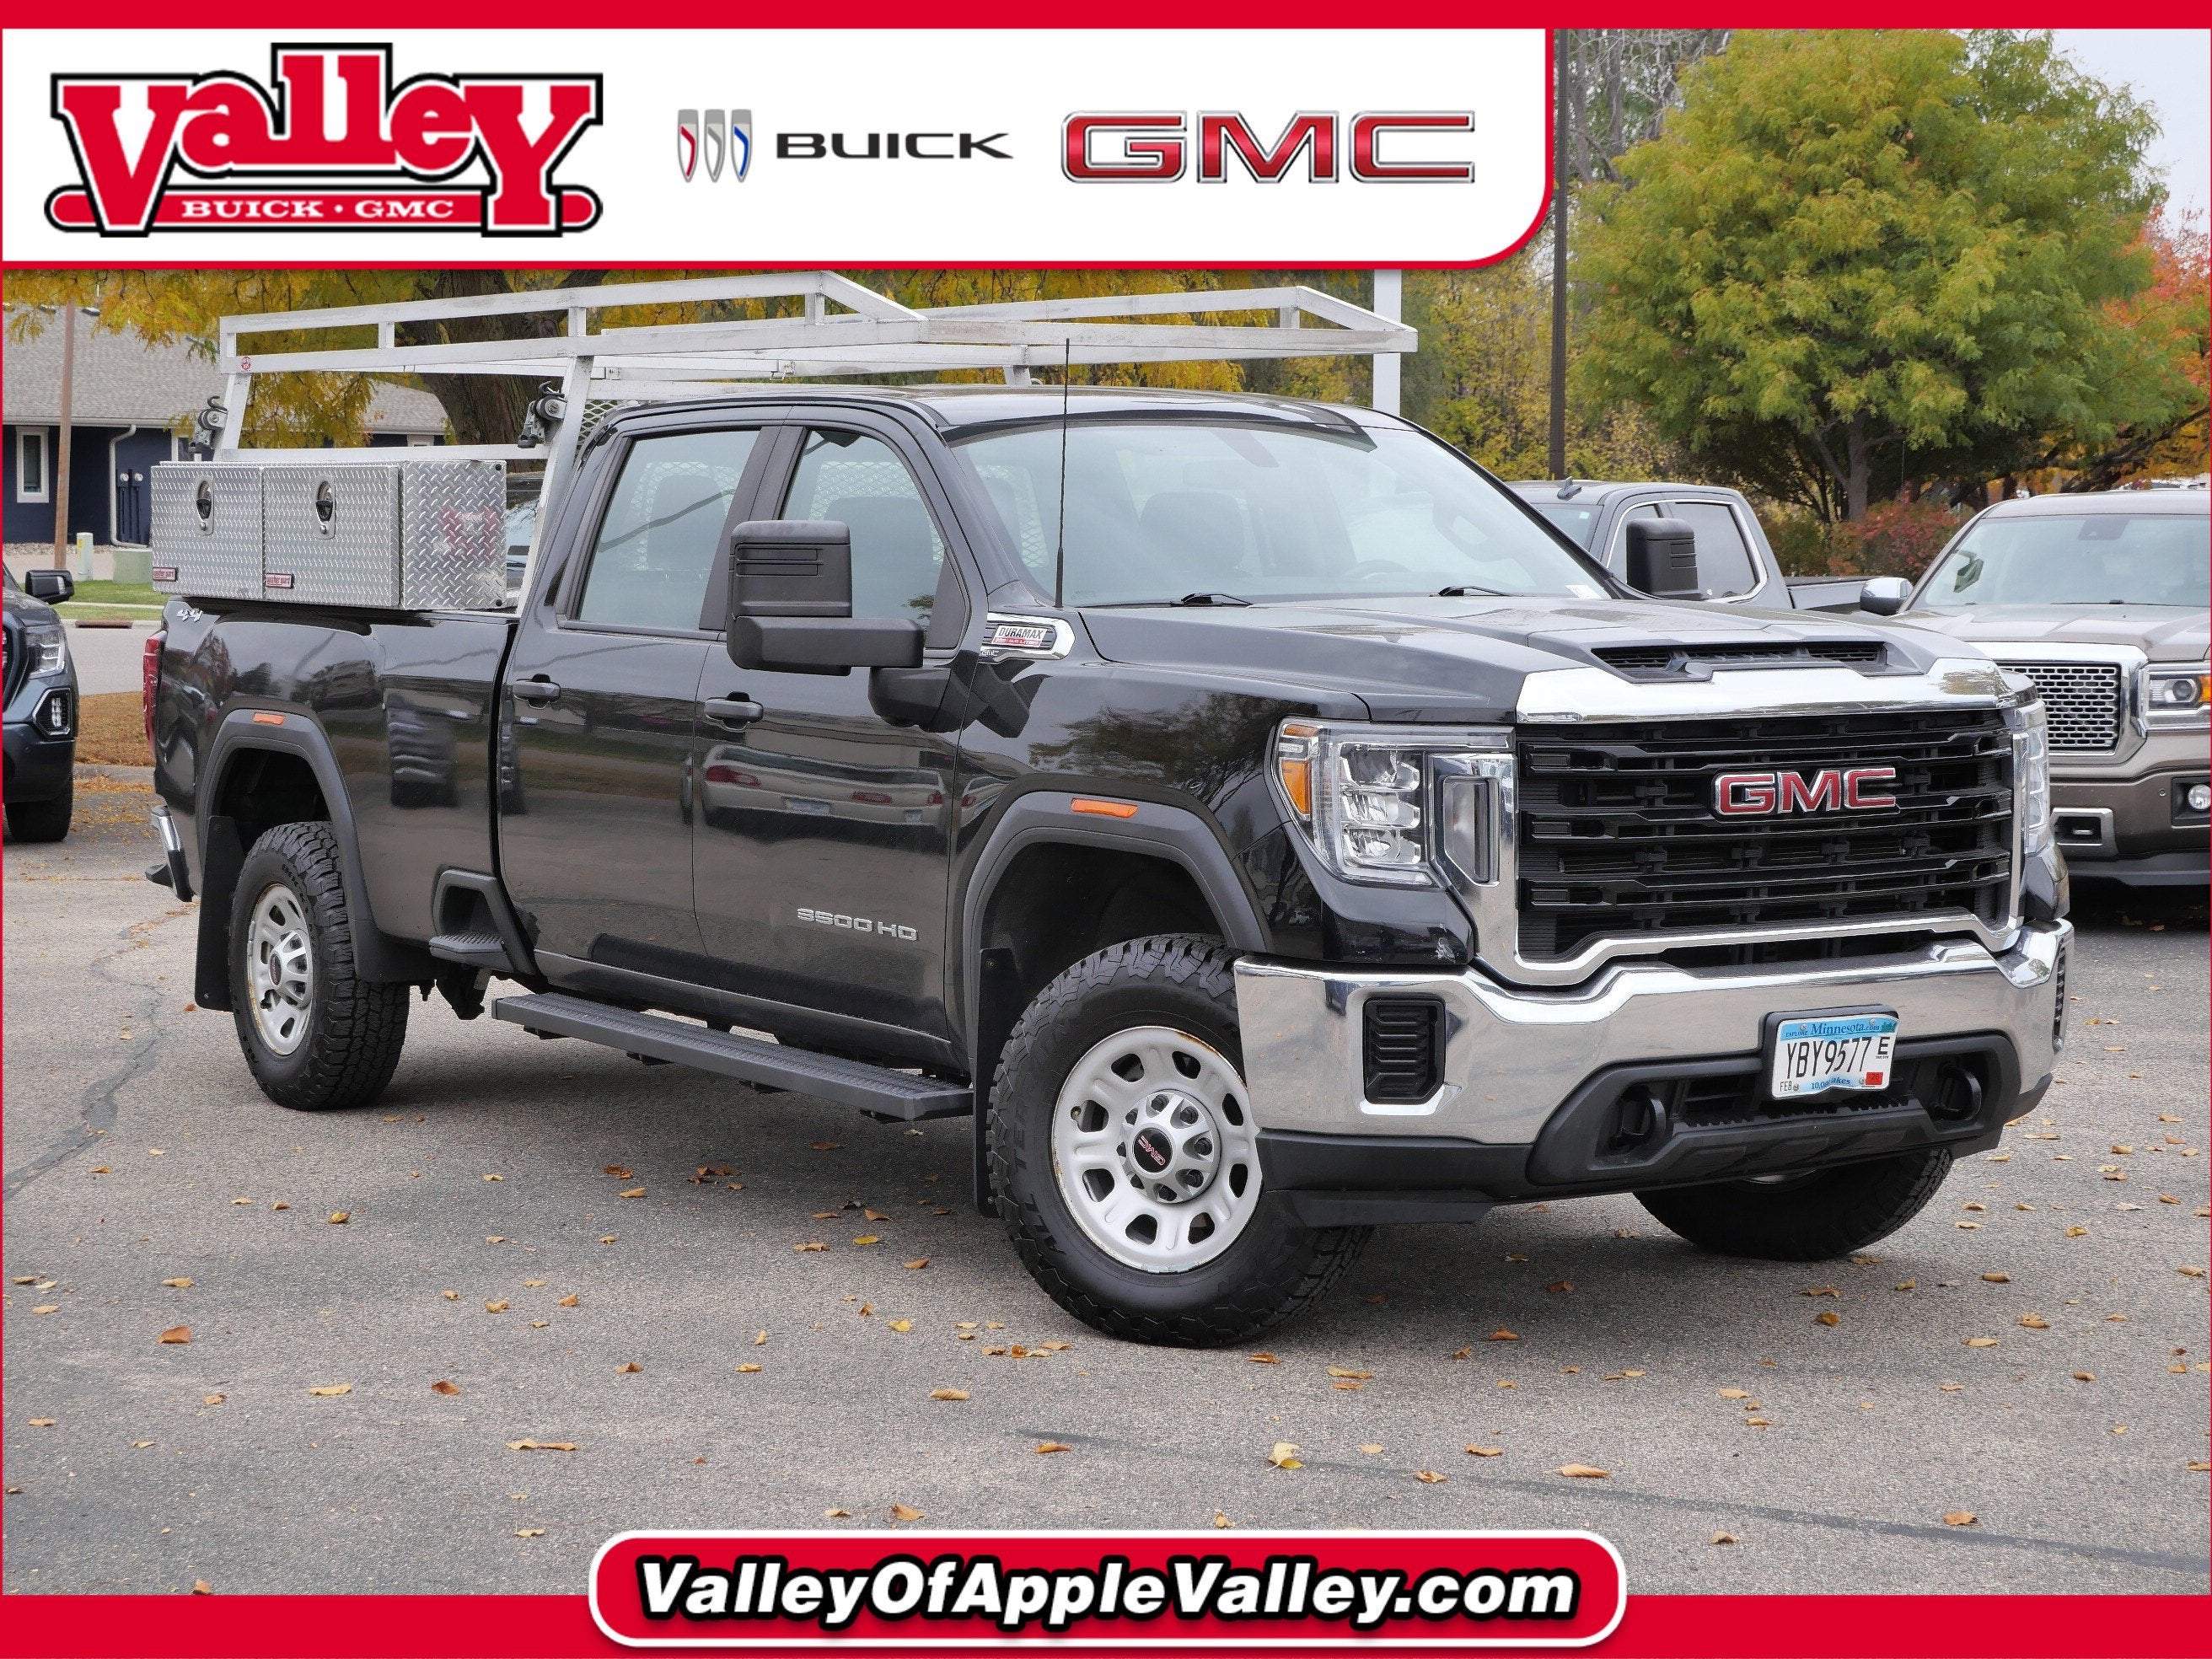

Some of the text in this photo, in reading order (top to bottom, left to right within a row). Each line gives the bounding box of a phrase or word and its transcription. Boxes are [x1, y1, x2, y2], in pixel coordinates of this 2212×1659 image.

[999, 627, 1044, 640] DURAMAX
[1715, 767, 1897, 816] GMC
[878, 921, 919, 942] HD
[1811, 1023, 1880, 1035] Minnesota.com
[1787, 1036, 1890, 1079] YBY9577 E
[1780, 1081, 1792, 1093] FEB
[1137, 1135, 1166, 1166] GMC
